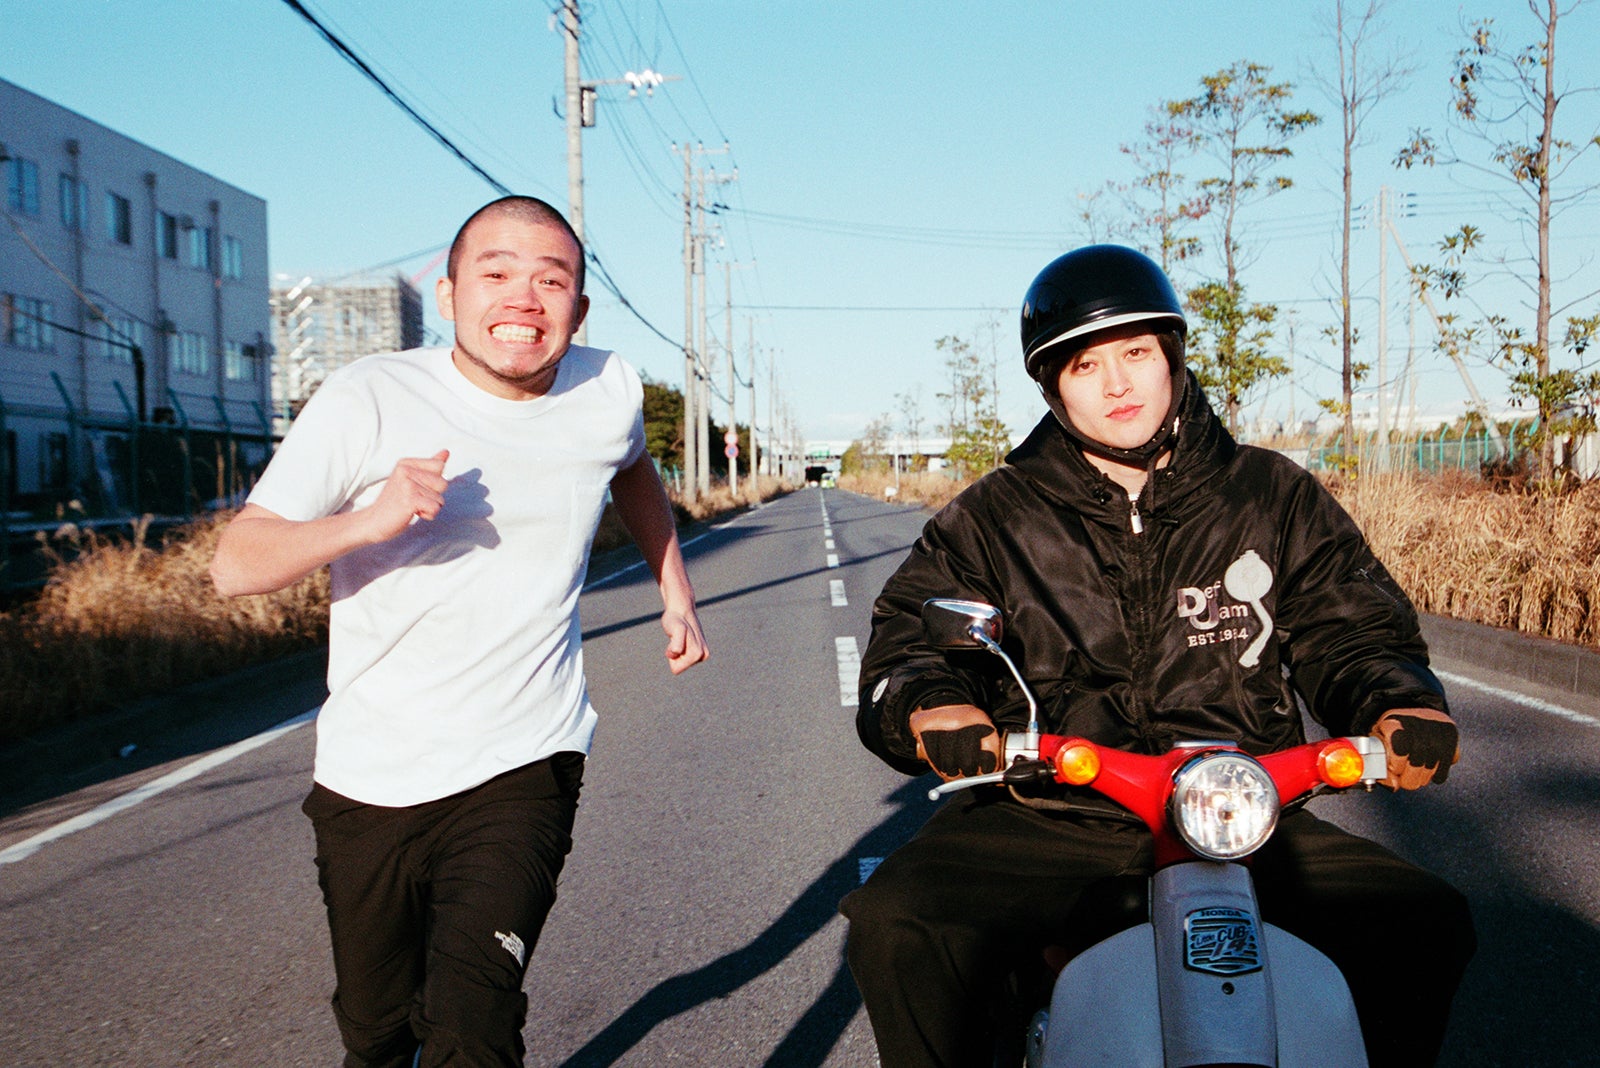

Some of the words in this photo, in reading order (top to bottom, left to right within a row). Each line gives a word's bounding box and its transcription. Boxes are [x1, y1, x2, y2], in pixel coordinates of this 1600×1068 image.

[1177, 580, 1221, 618] Def
[1189, 599, 1249, 630] Jam
[1201, 909, 1242, 917] HONDA
[1217, 925, 1246, 942] CUB
